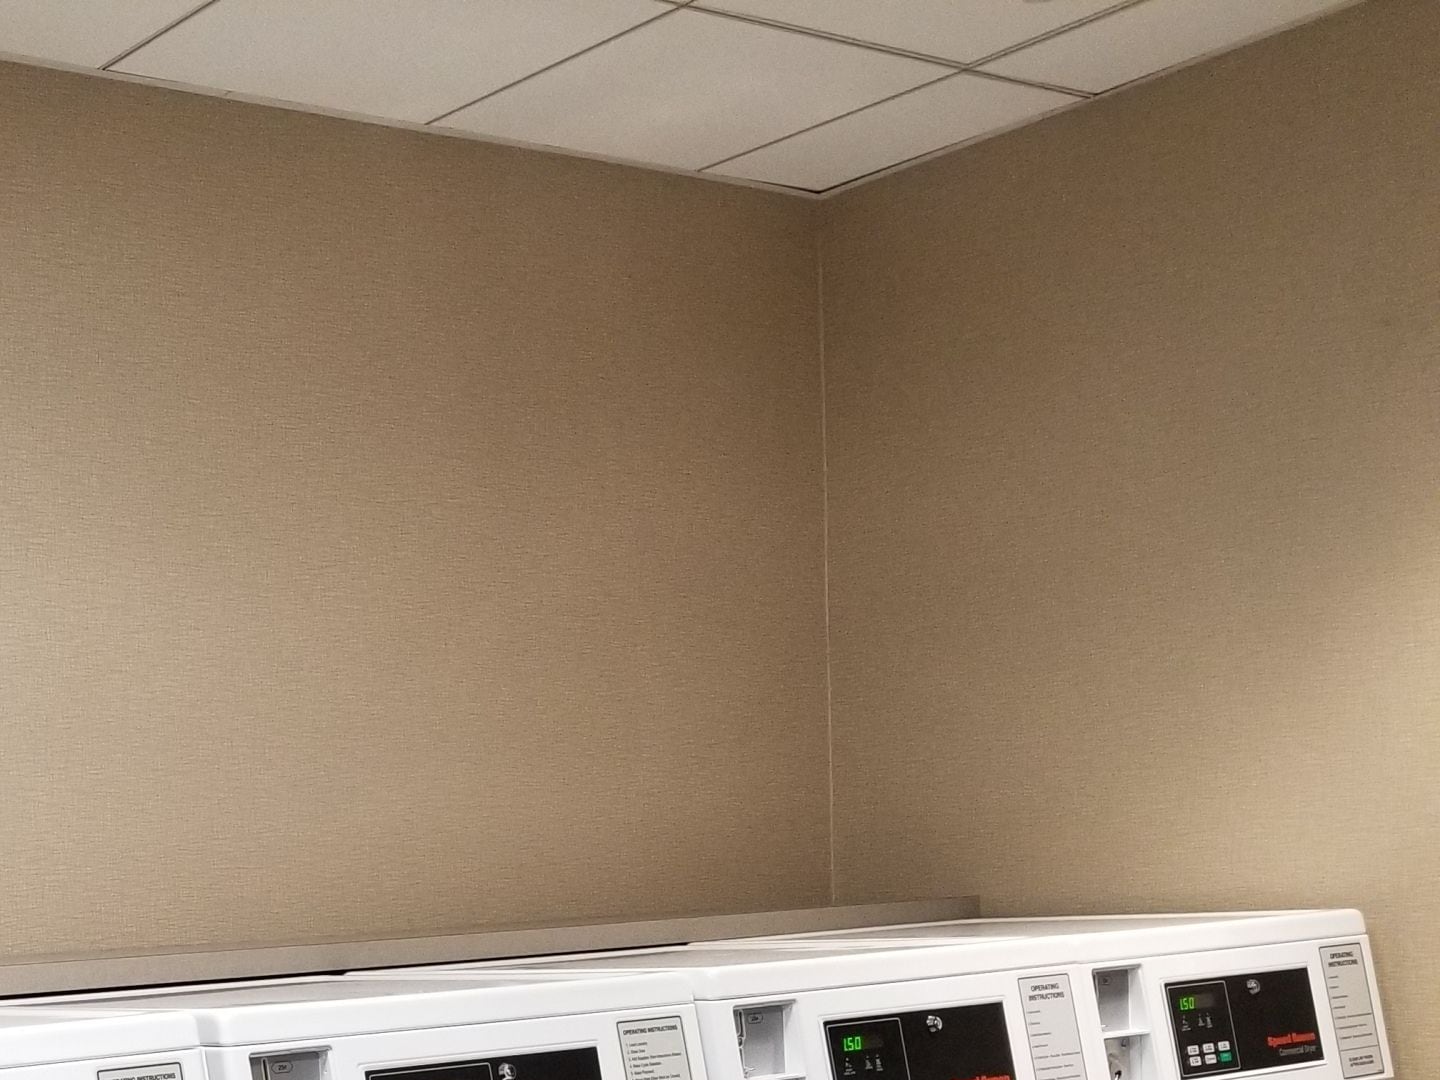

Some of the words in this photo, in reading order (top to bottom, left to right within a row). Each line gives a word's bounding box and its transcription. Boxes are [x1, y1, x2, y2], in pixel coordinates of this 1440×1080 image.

[1030, 983, 1059, 992] OPERATING
[1028, 991, 1065, 1001] INSTRUCTIONS
[648, 1024, 678, 1033] INSTRUCTIONS
